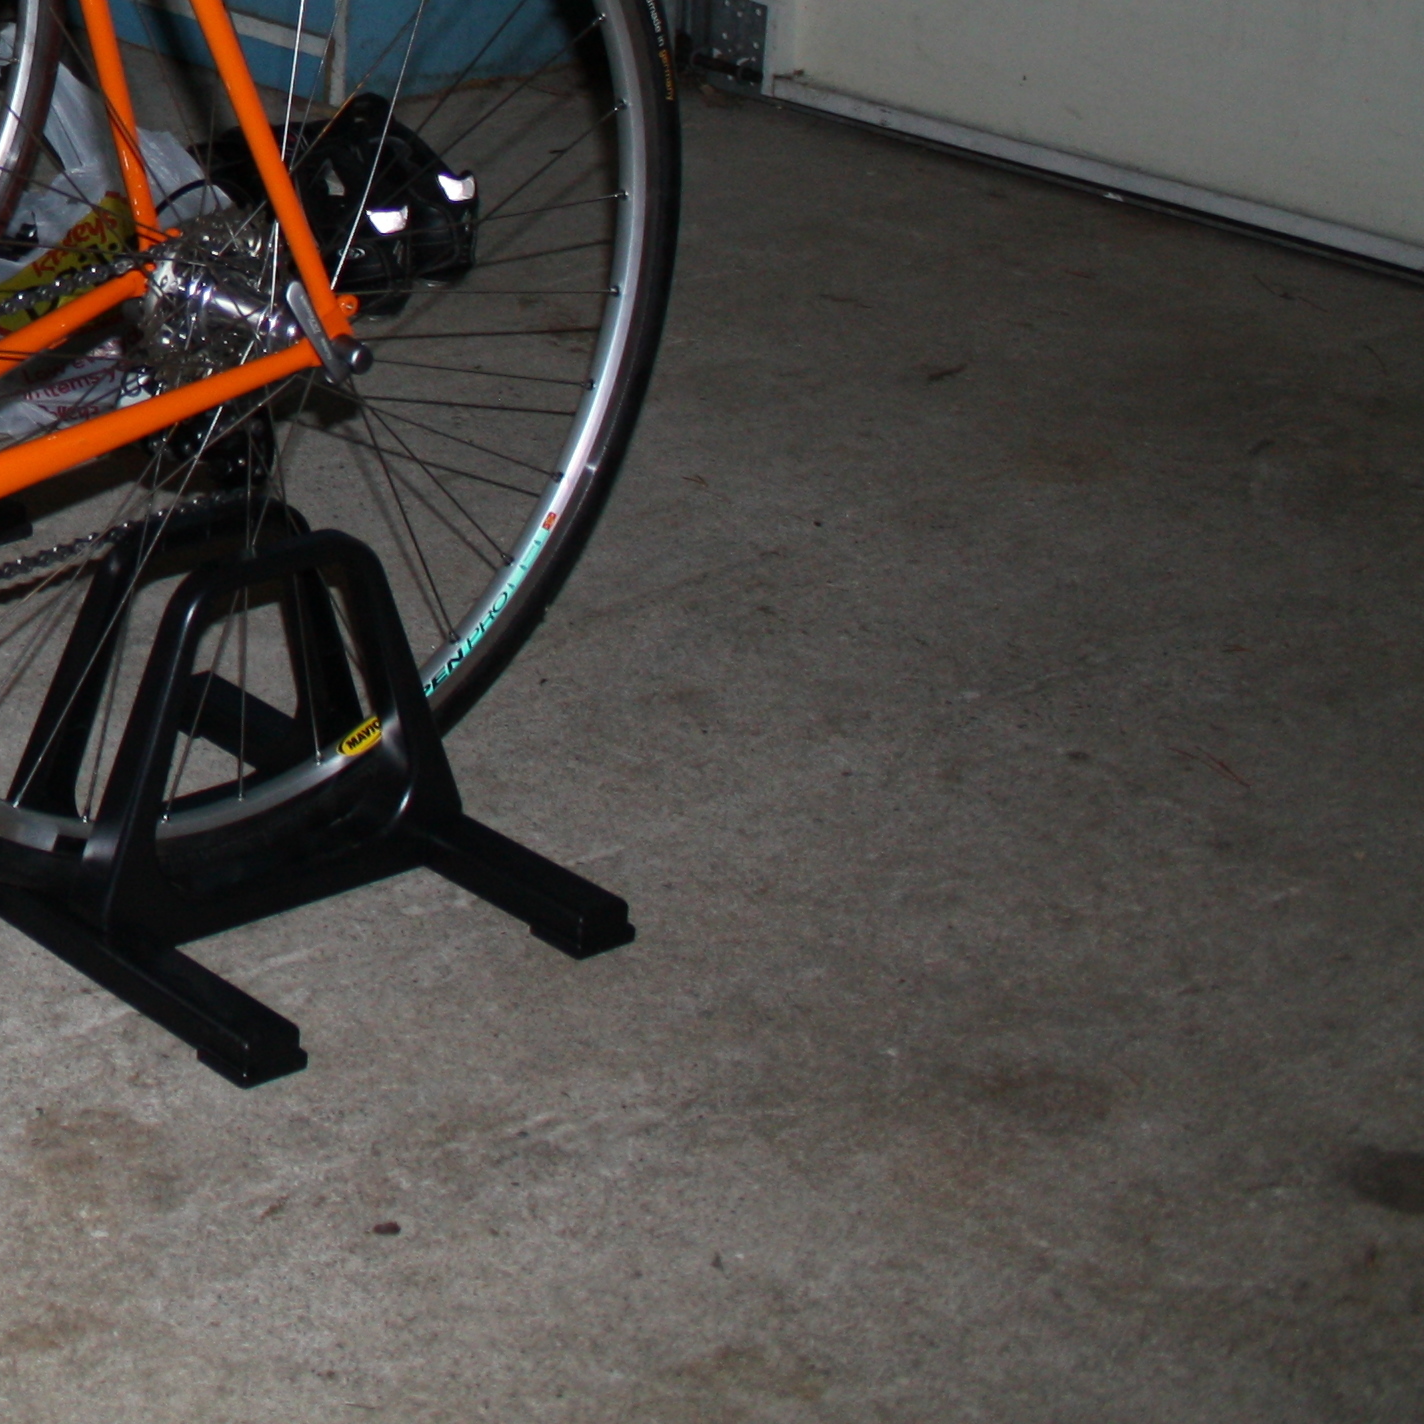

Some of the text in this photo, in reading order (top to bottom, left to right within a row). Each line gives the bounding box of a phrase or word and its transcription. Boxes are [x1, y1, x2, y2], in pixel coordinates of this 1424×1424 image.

[657, 34, 665, 47] in
[658, 48, 674, 102] germany
[346, 719, 382, 752] MAVIC
